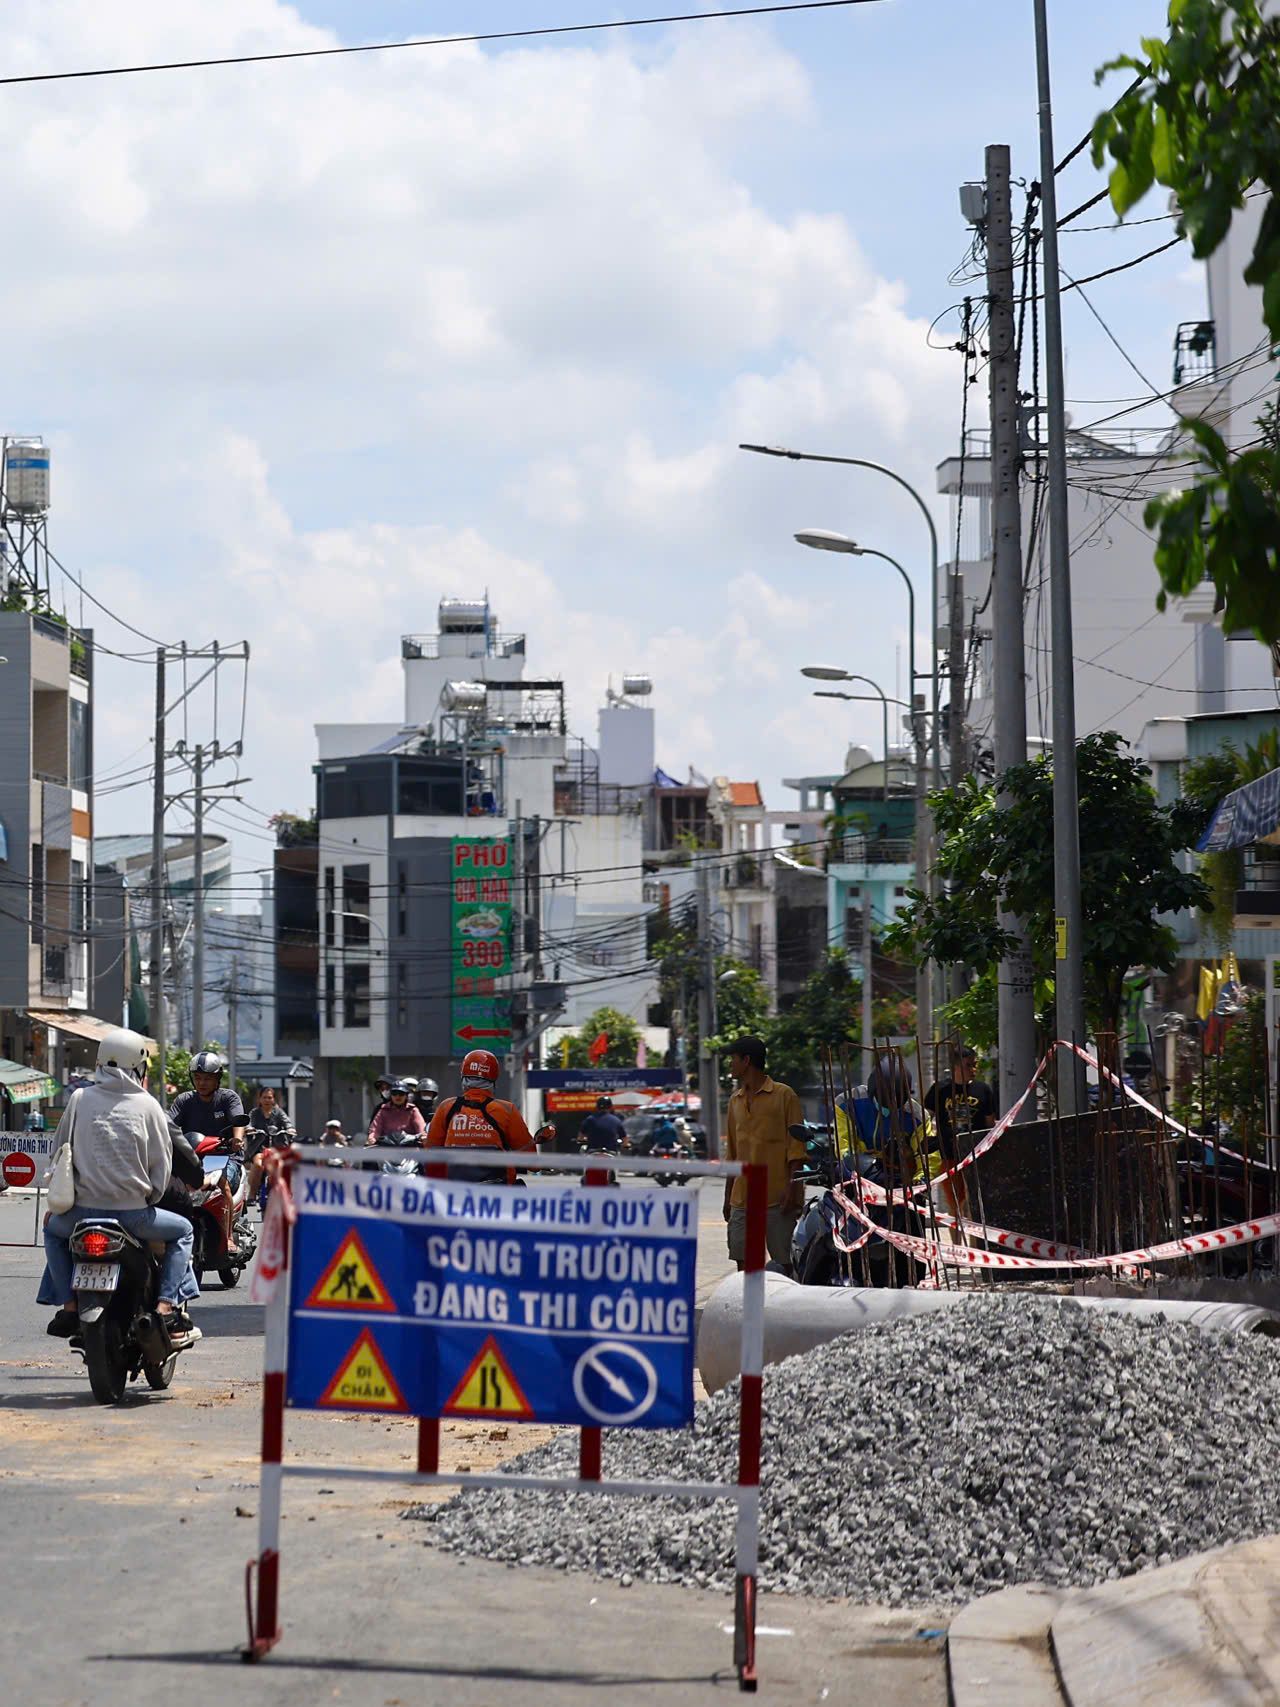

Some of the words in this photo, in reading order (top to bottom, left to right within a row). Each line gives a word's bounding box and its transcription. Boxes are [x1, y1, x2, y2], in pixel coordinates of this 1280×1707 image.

[455, 838, 508, 867] PHỞ
[462, 940, 504, 967] 390
[17, 1138, 36, 1153] ĐANG
[37, 1139, 48, 1154] THI
[304, 1178, 345, 1206] XIN
[447, 1188, 502, 1219] LÀM
[601, 1194, 655, 1228] QUÝ
[664, 1202, 690, 1235] VỊ
[80, 1264, 112, 1277] 85-F1
[427, 1229, 522, 1277] CÔNG
[533, 1237, 679, 1284] TRƯỜNG
[413, 1280, 509, 1323] ĐANG
[518, 1291, 577, 1328] THI
[589, 1288, 690, 1335] CÔNG
